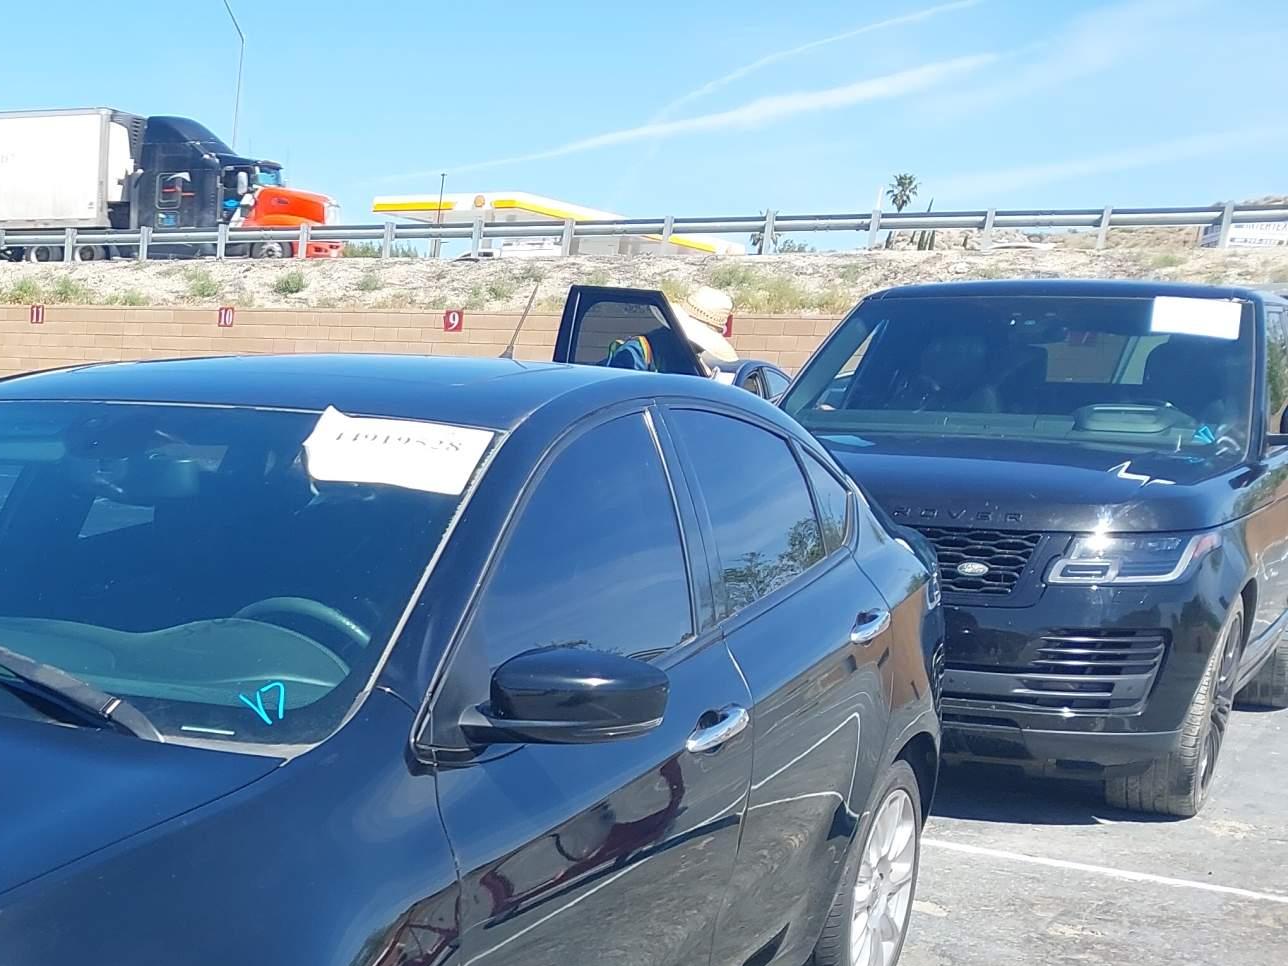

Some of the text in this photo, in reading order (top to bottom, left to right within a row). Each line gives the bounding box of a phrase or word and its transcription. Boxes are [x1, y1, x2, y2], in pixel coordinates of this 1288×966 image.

[31, 305, 44, 323] 11
[220, 307, 234, 326] 10
[448, 311, 460, 330] 9
[890, 506, 1024, 522] ROVER
